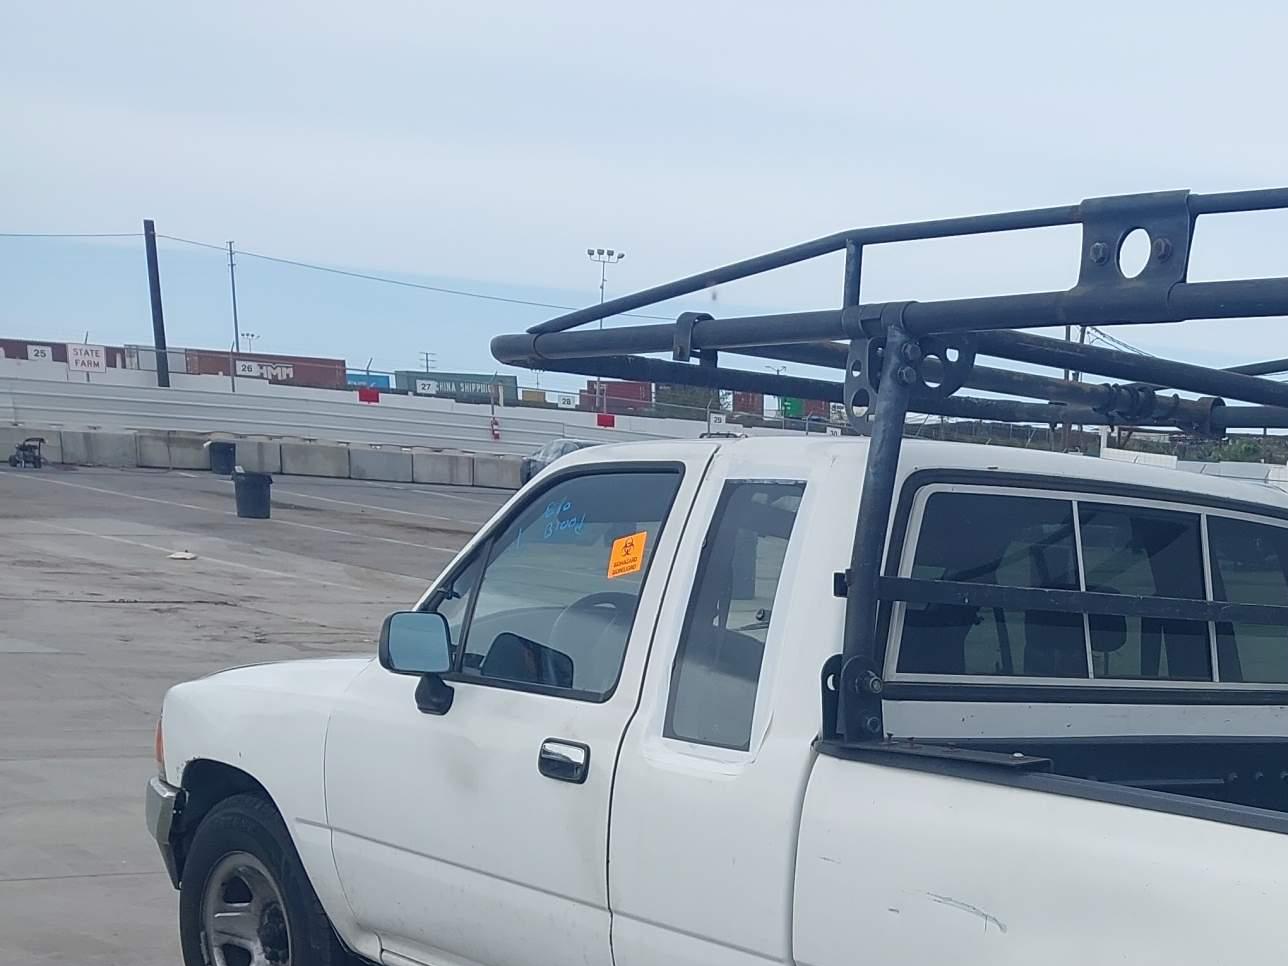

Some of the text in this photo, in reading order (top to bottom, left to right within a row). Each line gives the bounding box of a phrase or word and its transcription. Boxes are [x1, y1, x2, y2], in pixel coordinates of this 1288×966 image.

[33, 349, 47, 358] 25
[73, 348, 101, 358] STATE
[74, 359, 100, 368] FARM
[241, 363, 253, 372] 26
[421, 383, 431, 391] 27
